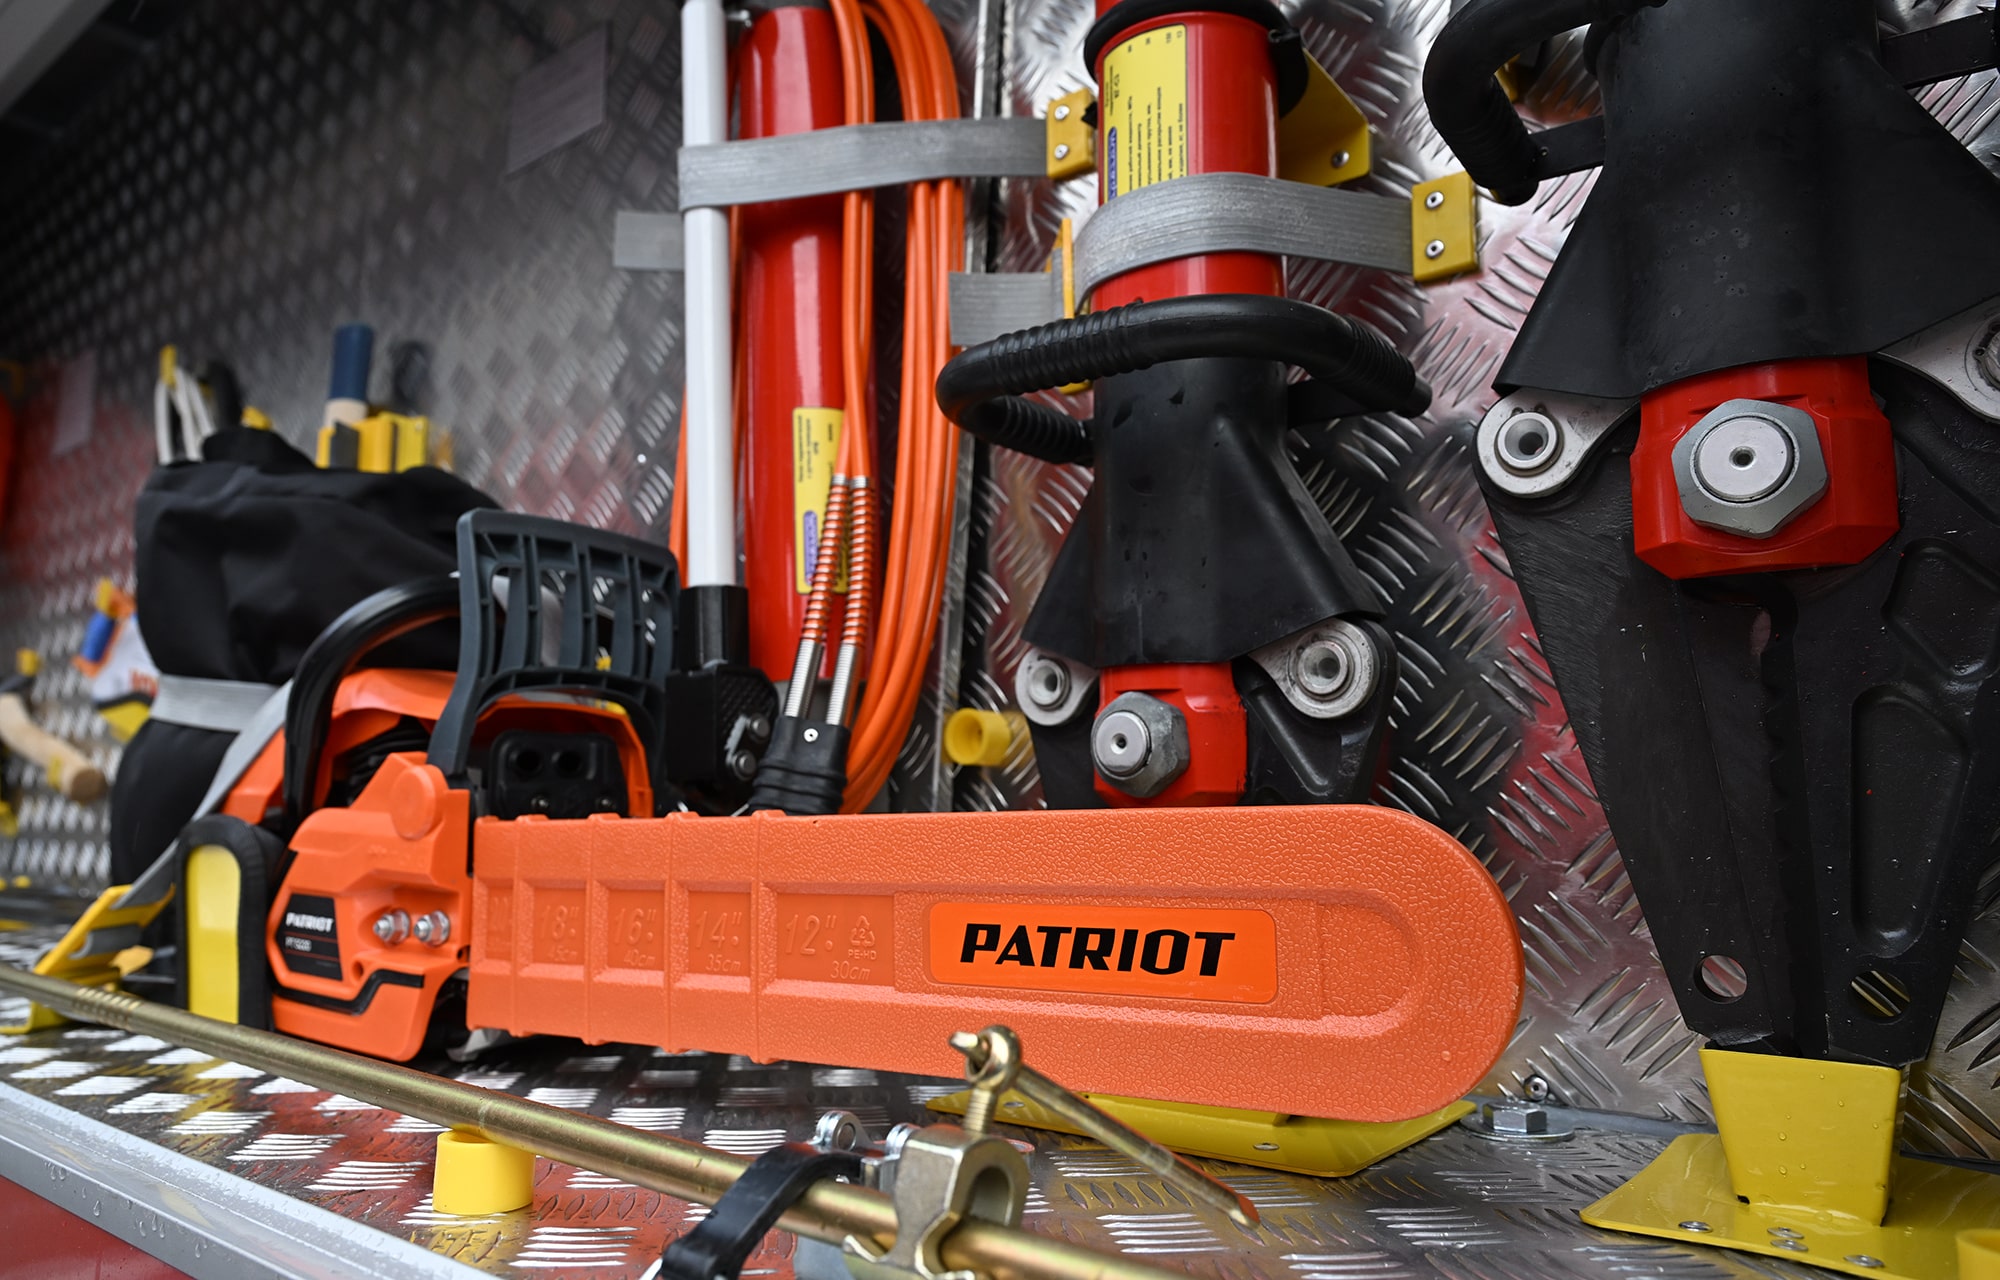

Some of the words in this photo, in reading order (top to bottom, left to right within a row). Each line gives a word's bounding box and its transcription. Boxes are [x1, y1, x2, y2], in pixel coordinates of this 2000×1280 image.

[286, 912, 334, 933] PATRIOT
[847, 949, 877, 960] PE-HD
[960, 923, 1236, 977] PATRIOT
[705, 953, 742, 973] 35cm
[830, 960, 871, 981] 30cm
